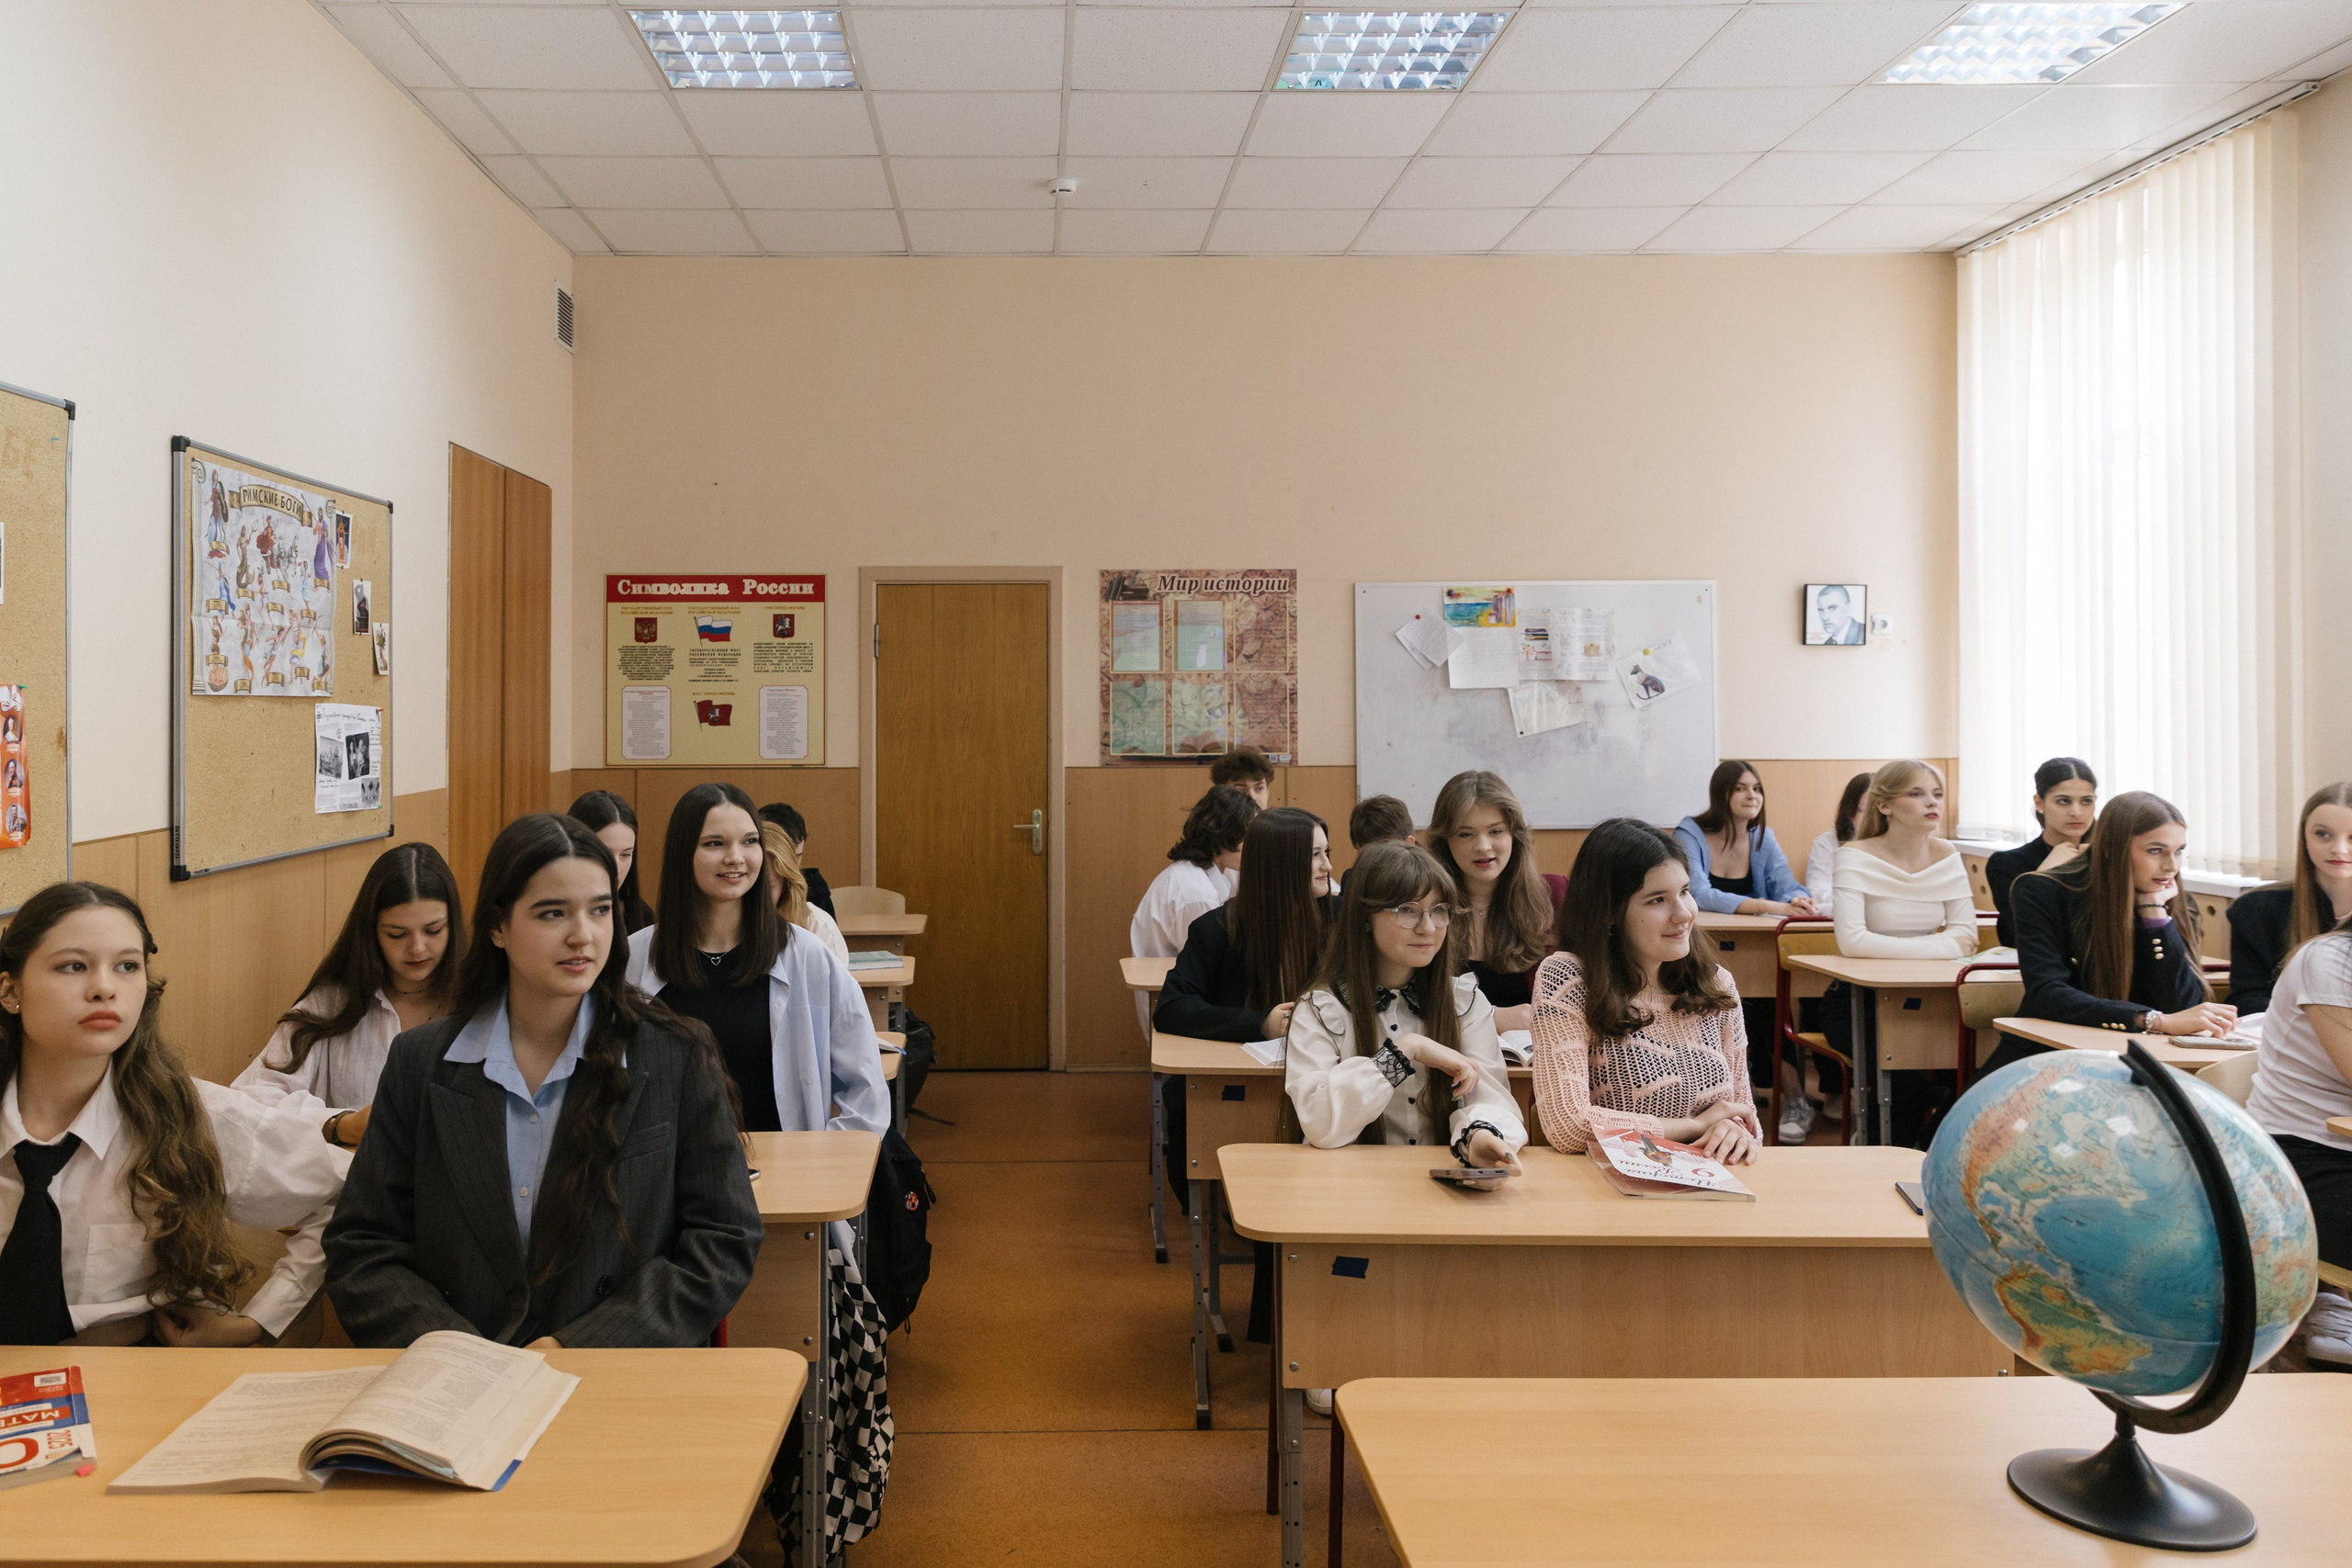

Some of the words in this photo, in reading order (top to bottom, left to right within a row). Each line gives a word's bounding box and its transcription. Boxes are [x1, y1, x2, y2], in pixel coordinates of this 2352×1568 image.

[243, 488, 278, 506] РИМСКИЕ
[280, 495, 302, 516] БОГИ
[617, 579, 729, 595] Символика
[742, 579, 814, 595] России
[1157, 575, 1199, 595] Мир
[1204, 578, 1288, 595] истории
[1617, 1159, 1683, 1177] России
[1624, 1168, 1723, 1190] История
